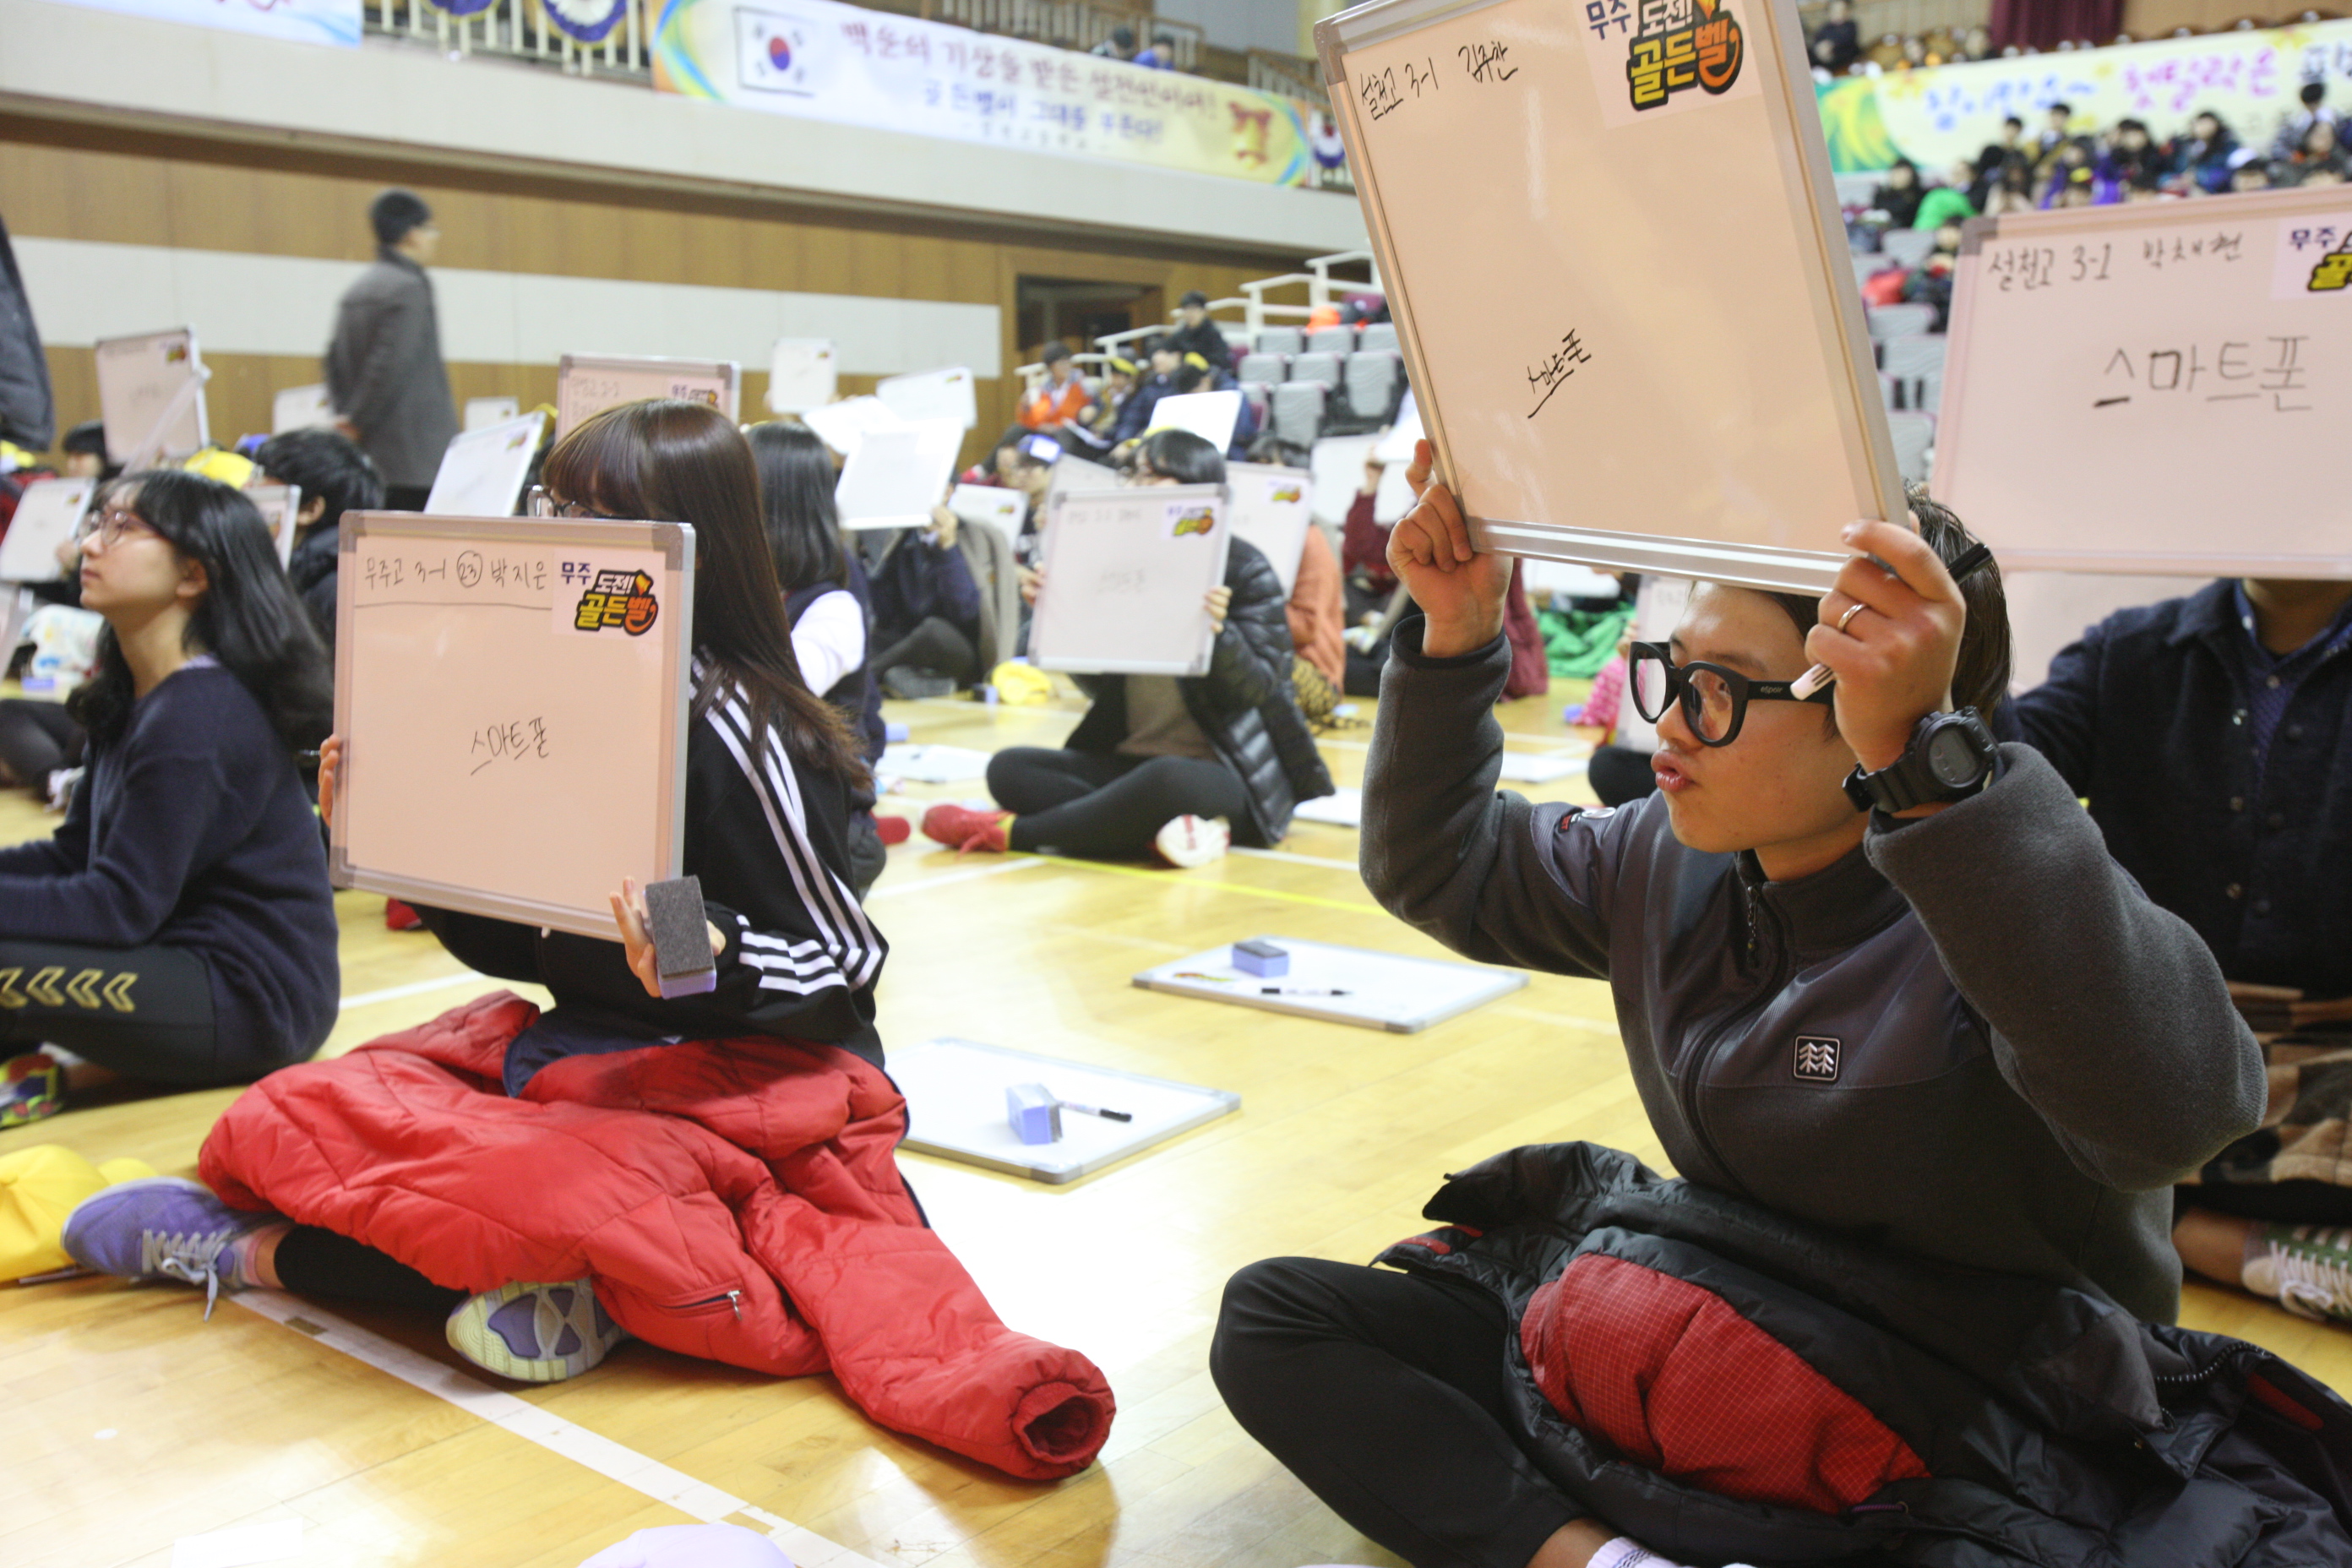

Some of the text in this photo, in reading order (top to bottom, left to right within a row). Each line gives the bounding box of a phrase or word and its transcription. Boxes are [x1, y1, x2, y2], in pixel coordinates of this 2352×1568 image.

[1631, 18, 1740, 105] 골든벨
[2290, 226, 2336, 251] 무주
[2070, 242, 2111, 281] 3-1
[2093, 335, 2313, 412] 스마트폰
[365, 557, 404, 590] 무주고
[560, 562, 591, 585] 무주
[577, 593, 657, 633] 골든벨
[470, 716, 549, 776] 스마트폰
